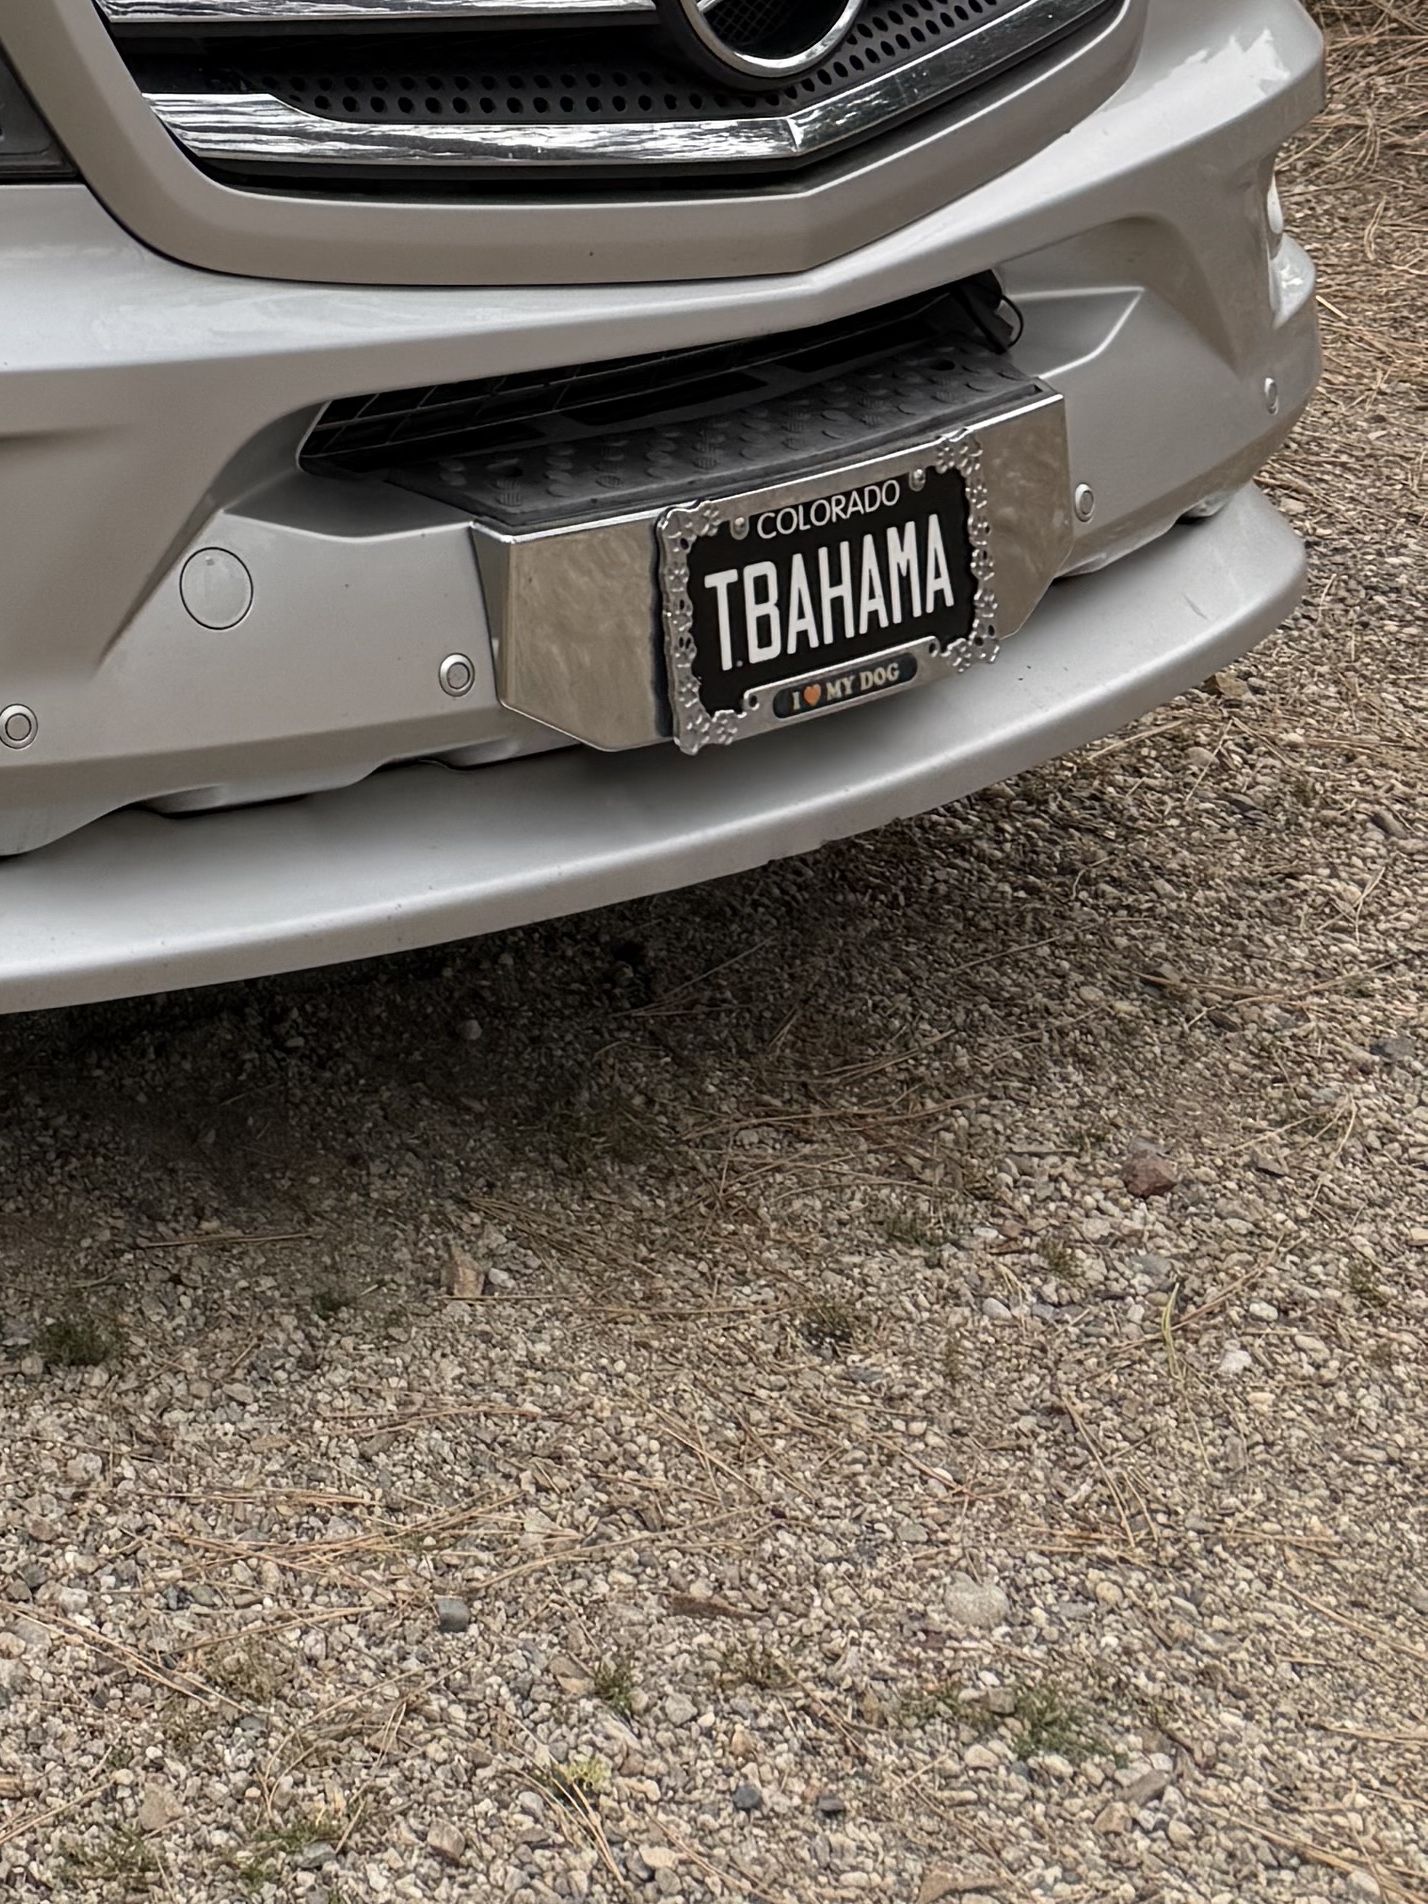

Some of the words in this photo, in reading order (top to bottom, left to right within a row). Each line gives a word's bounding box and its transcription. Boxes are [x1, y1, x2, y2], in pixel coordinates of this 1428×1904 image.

[756, 479, 900, 541] COLORADO
[704, 513, 955, 671] TBAHAMA
[791, 690, 801, 712] I
[826, 675, 856, 702] MY
[859, 662, 900, 691] DOG
